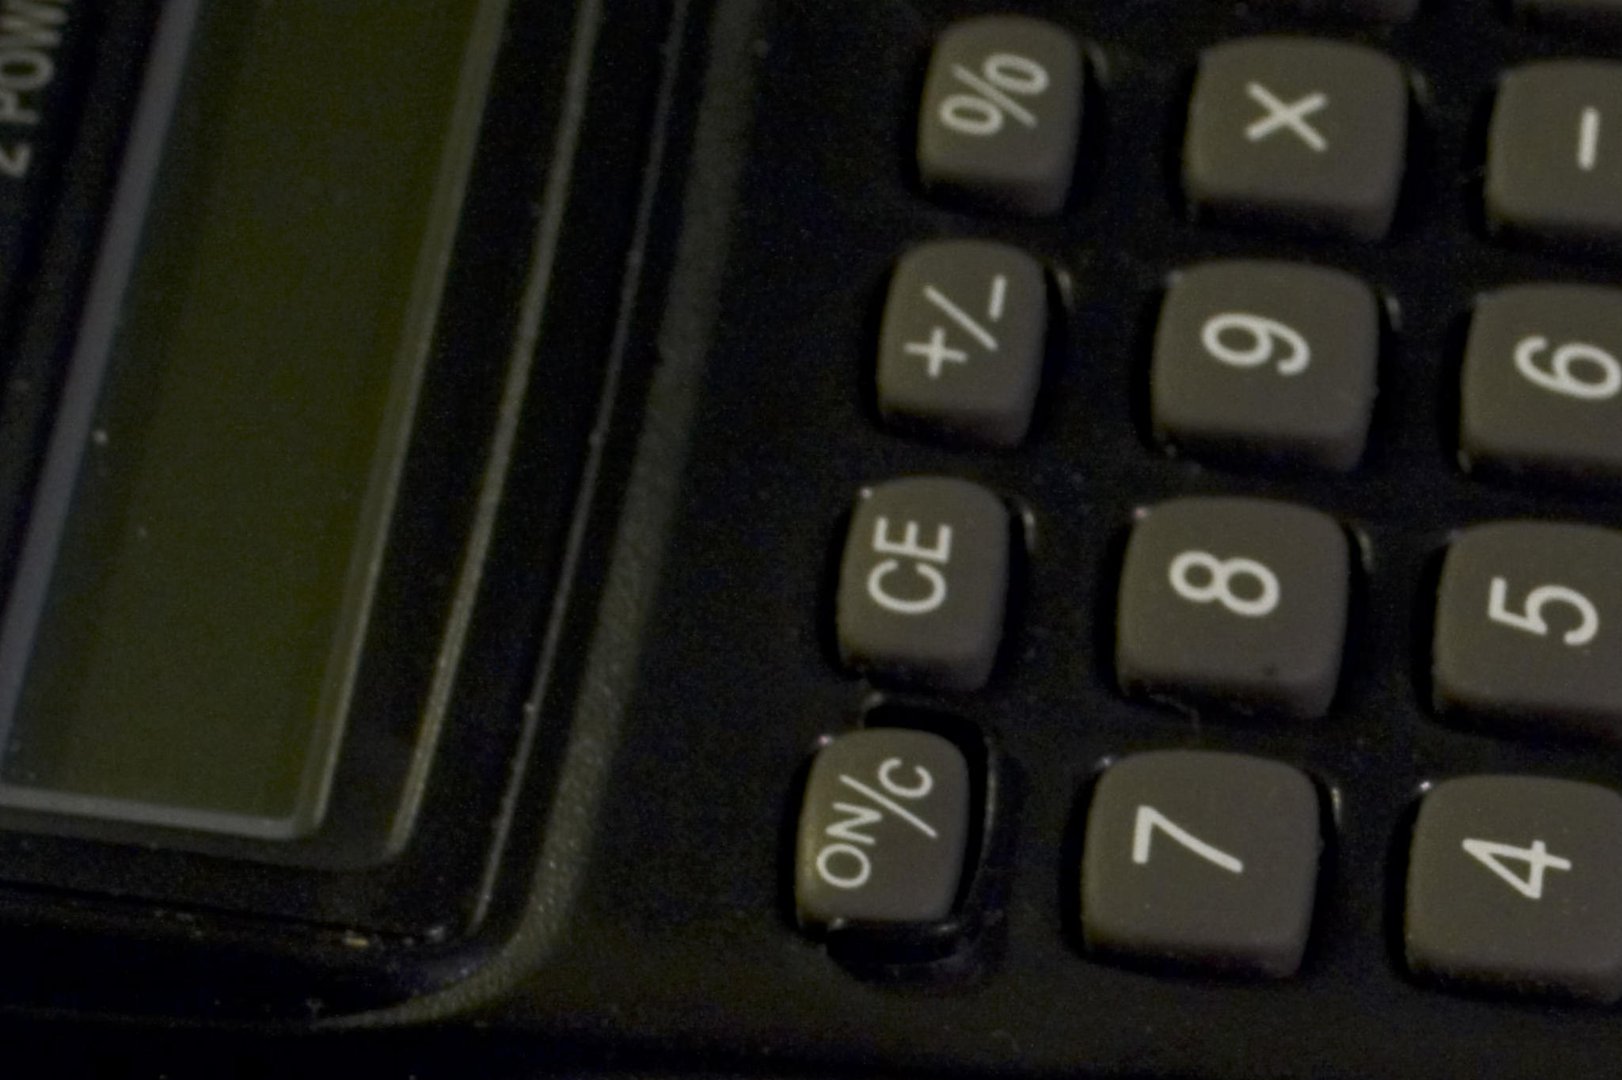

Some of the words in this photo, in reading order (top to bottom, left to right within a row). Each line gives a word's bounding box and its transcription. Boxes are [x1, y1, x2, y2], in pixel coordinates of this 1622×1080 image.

[941, 57, 1048, 135] %
[1201, 312, 1311, 375] 9
[866, 516, 952, 614] CE
[1168, 550, 1280, 617] 8
[1487, 576, 1600, 646] 5
[1131, 804, 1244, 874] 7
[1461, 837, 1573, 900] 4
